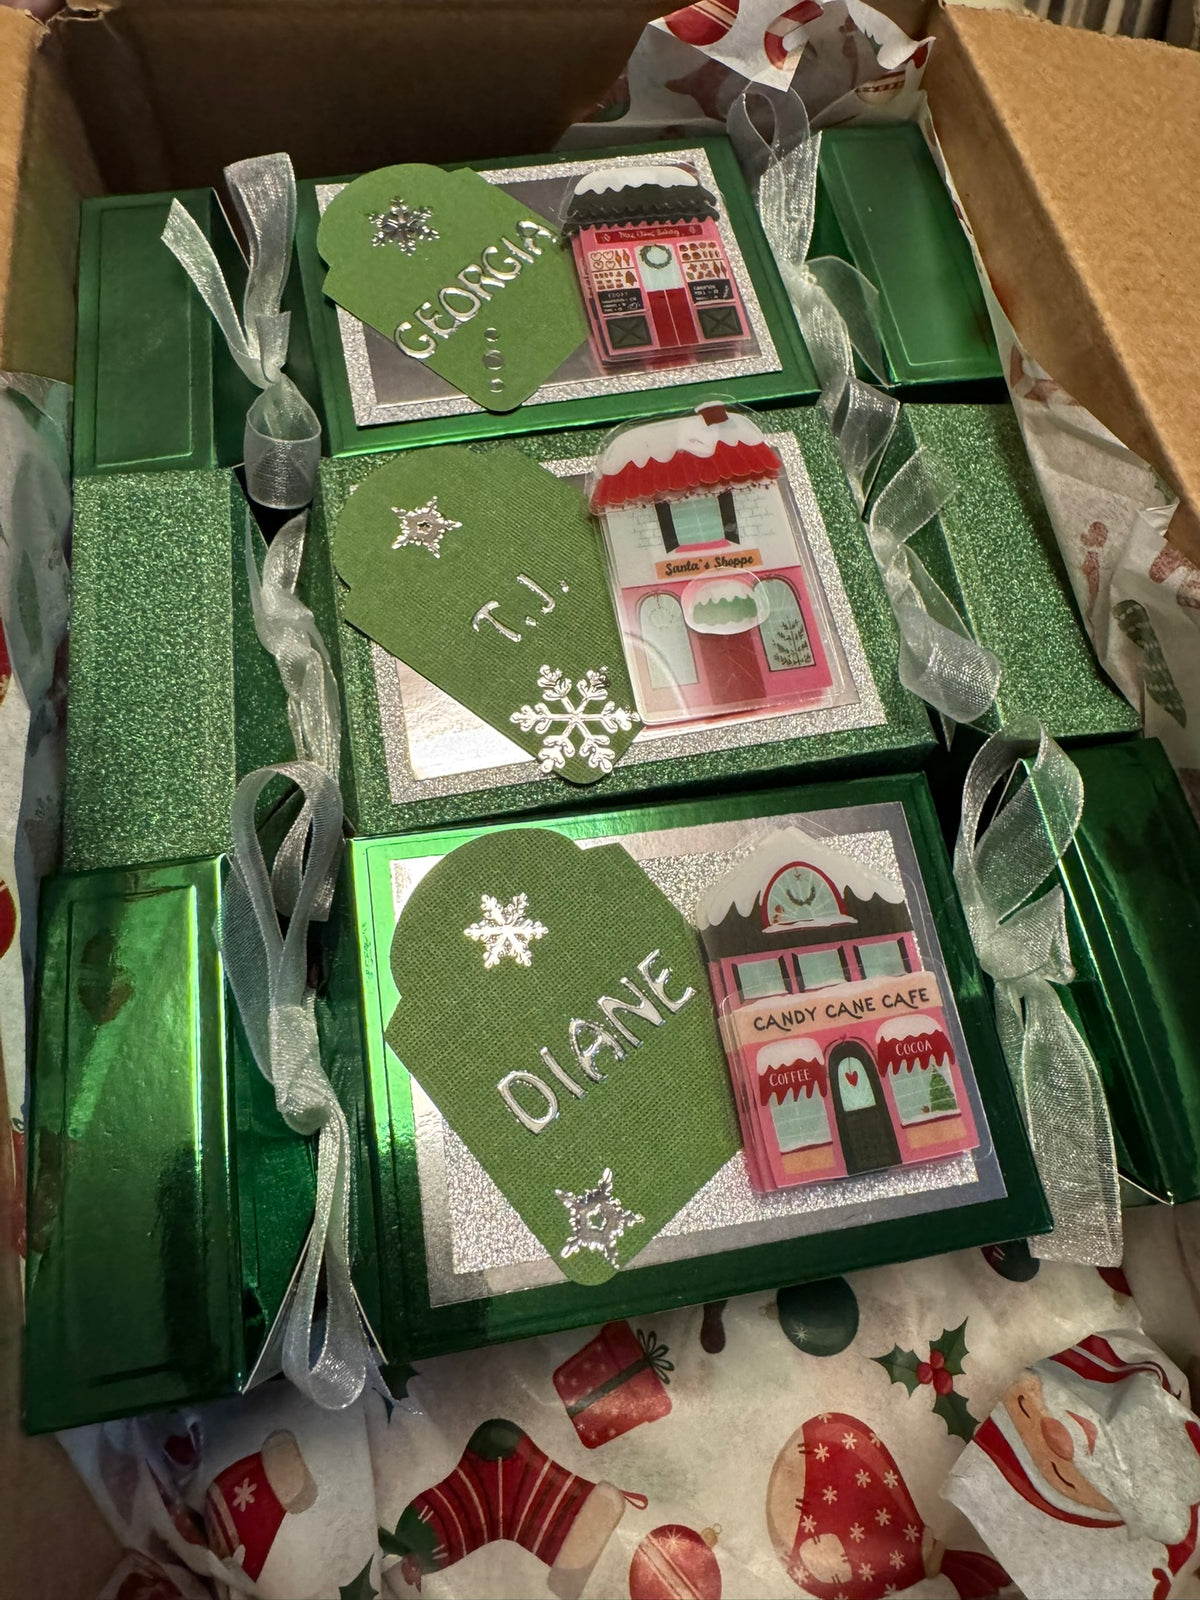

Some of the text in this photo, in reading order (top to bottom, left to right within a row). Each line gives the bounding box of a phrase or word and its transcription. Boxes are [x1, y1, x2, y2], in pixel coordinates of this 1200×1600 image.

[395, 219, 558, 359] GEORGIA
[664, 555, 754, 576] Santa's Shoppe
[472, 573, 570, 642] T.J.
[753, 988, 930, 1032] CANDY CANE CAFE
[497, 949, 697, 1134] DIANE
[895, 1042, 933, 1057] COCOA
[769, 1068, 811, 1086] COFFEE
